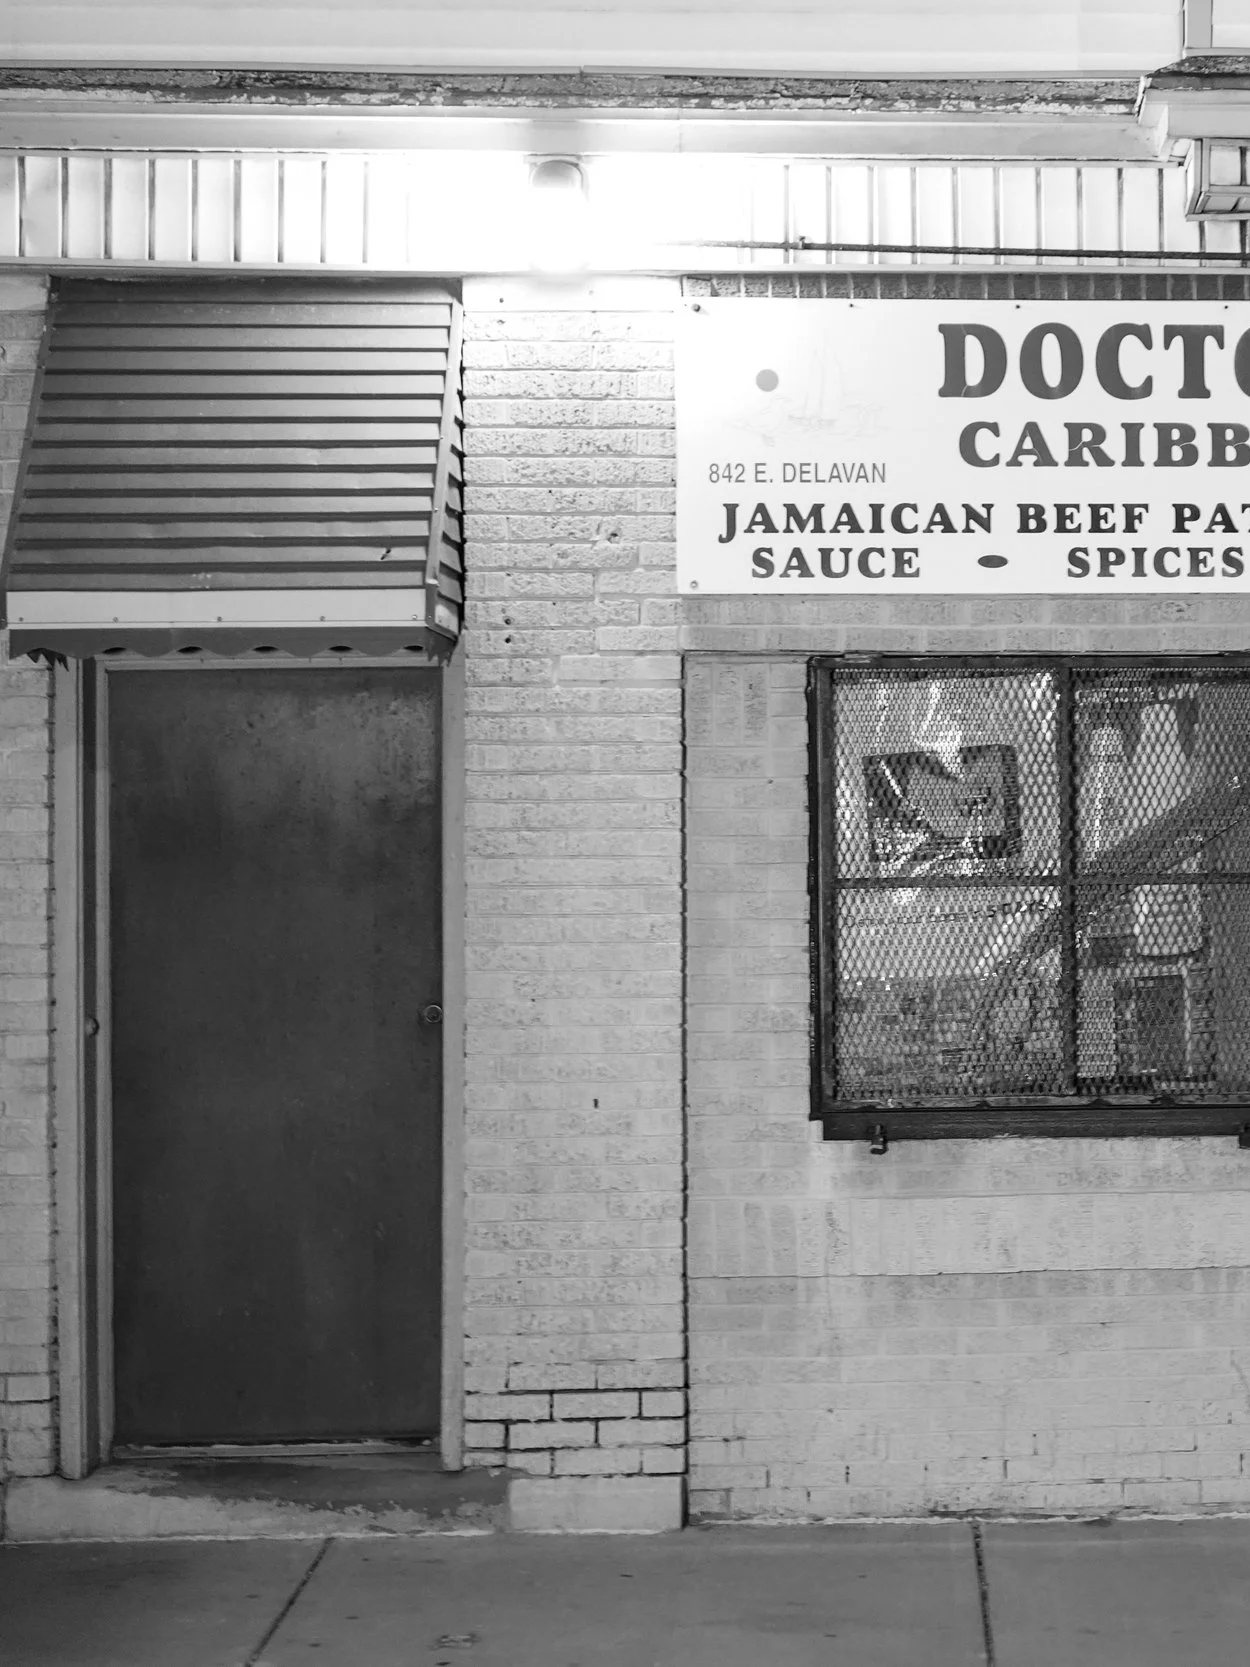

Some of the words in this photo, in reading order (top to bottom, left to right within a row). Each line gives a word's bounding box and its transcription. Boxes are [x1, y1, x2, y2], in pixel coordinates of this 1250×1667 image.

[709, 463, 745, 483] 842
[755, 463, 773, 483] E.
[783, 463, 885, 483] DELAVAN
[718, 503, 994, 543] JAMAICAN
[1017, 504, 1149, 533] BEEF
[752, 547, 920, 578] SAUCE
[1068, 547, 1244, 578] SPICES
